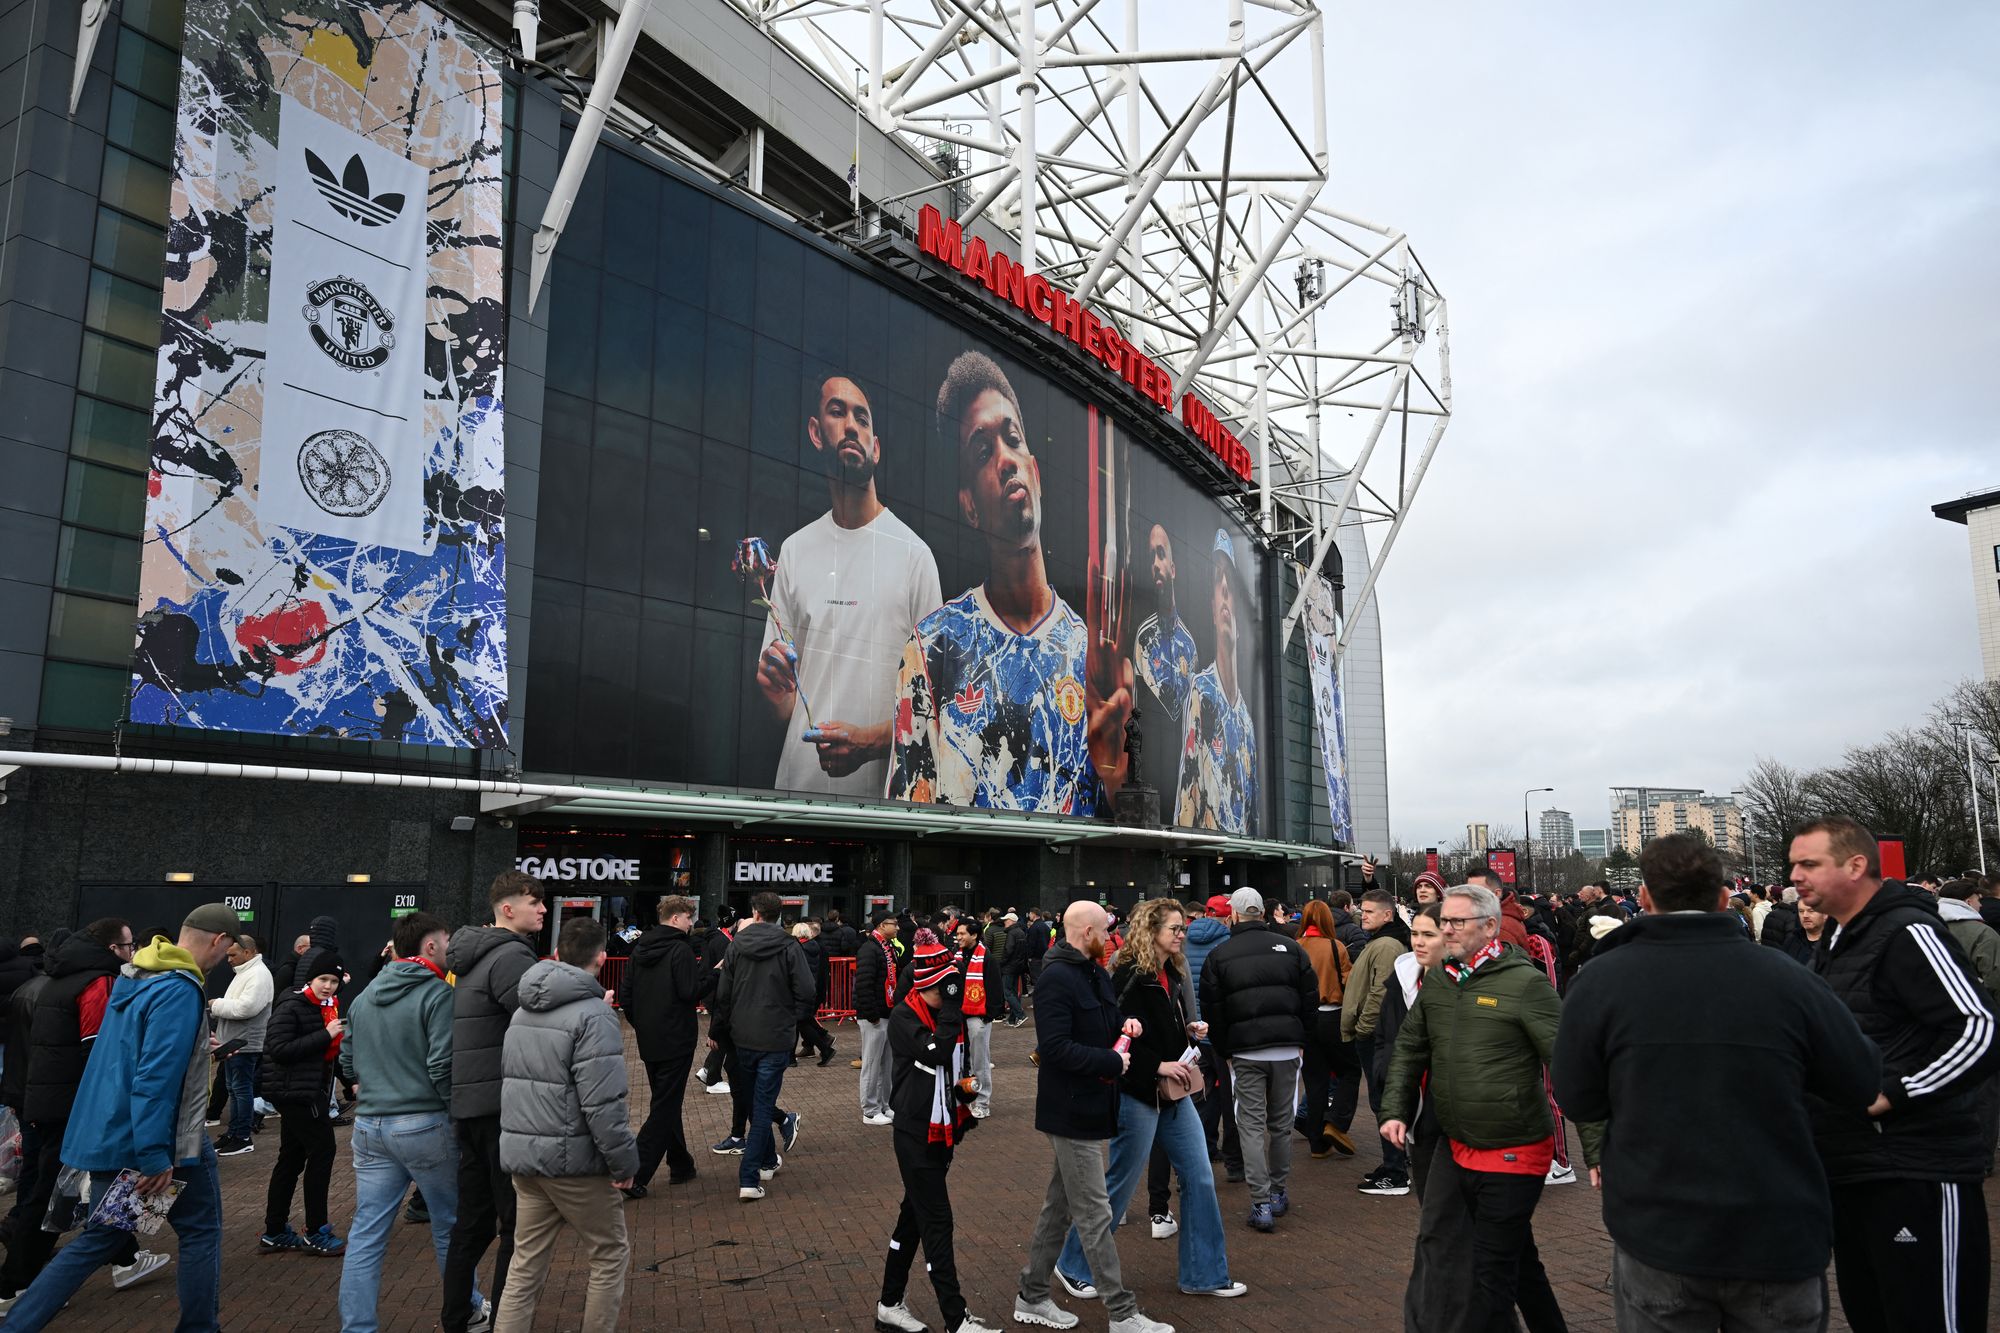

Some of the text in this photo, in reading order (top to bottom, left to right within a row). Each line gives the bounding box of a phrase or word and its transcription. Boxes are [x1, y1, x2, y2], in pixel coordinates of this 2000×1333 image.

[313, 283, 387, 327] MANCHESTER
[323, 341, 375, 367] UNITED
[919, 204, 1251, 482] MANCHESTER UNITED
[735, 862, 833, 882] ENTRANCE
[395, 895, 415, 907] EX10
